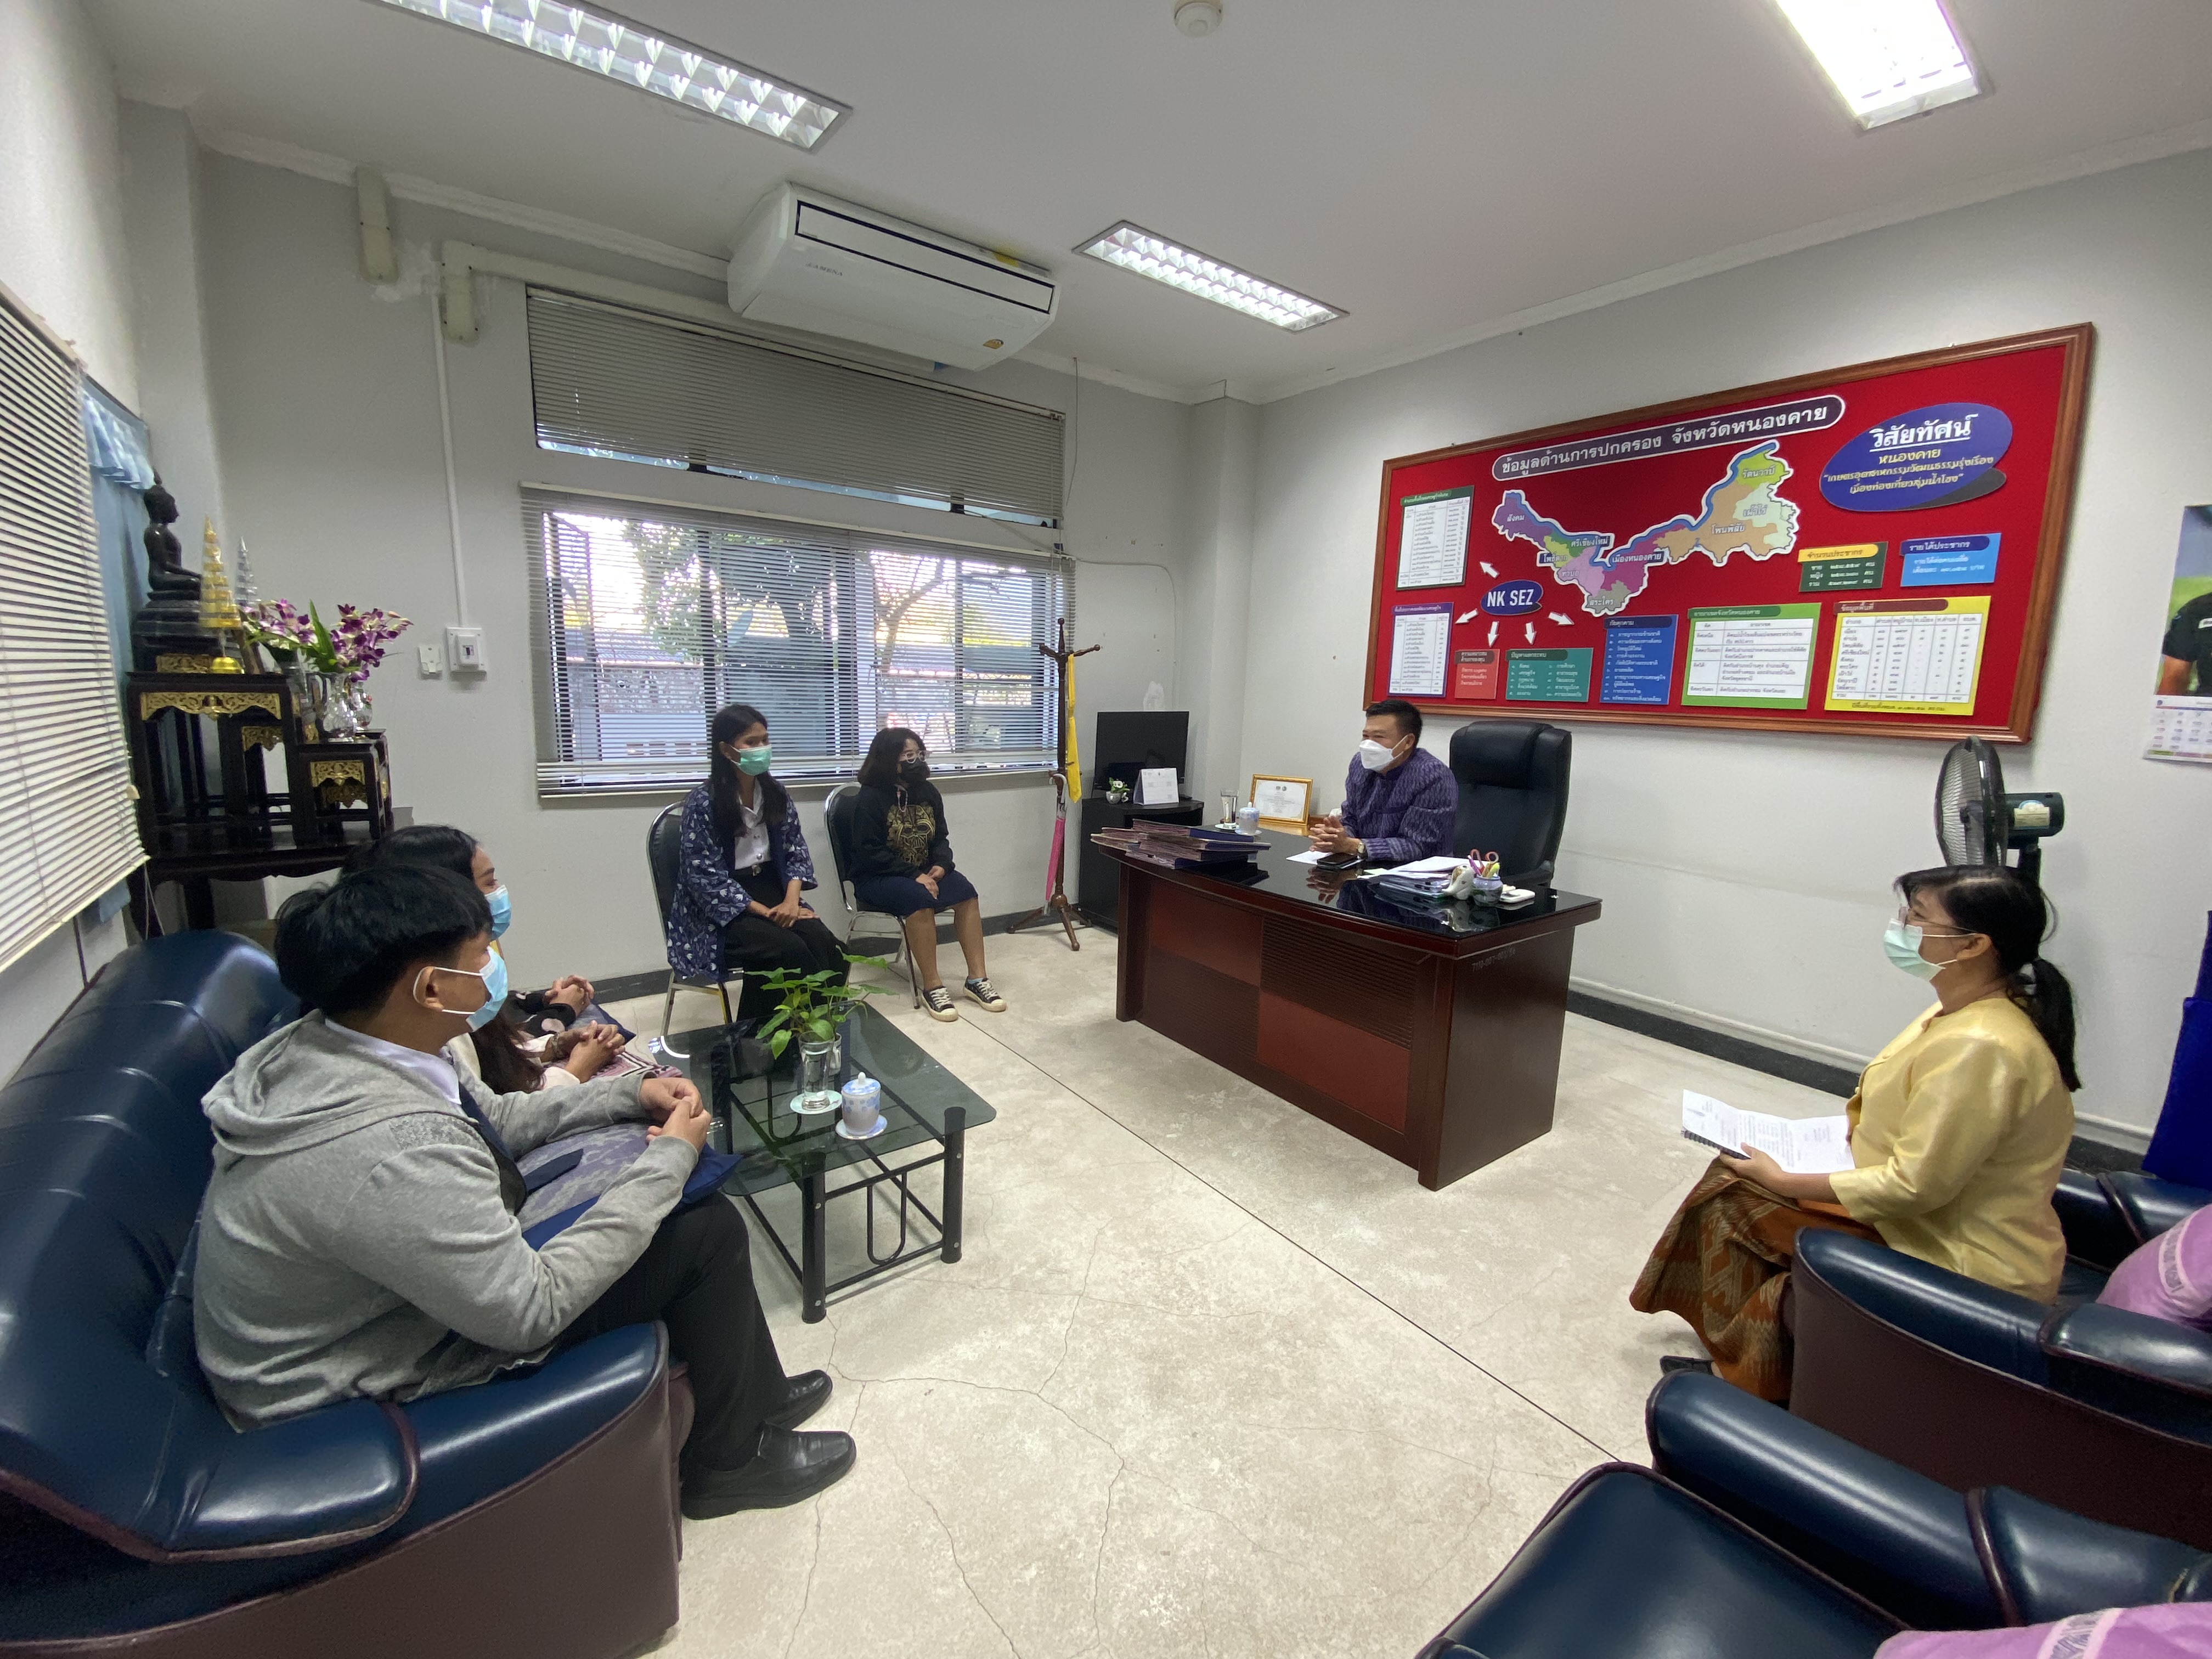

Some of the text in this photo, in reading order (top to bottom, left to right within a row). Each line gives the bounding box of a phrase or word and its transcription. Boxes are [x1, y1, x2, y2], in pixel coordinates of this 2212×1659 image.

[1870, 414, 1978, 448] วิสัยทัศน์
[1502, 404, 1828, 476] ข้อมูลด้านการปกครอง จังหวัดหนองคาย
[1879, 449, 1941, 465] หนองคาย
[1711, 523, 1746, 534] โพนพิสัย
[1611, 548, 1662, 563] เมืองหนองคาย
[1487, 589, 1534, 607] NK SEZ
